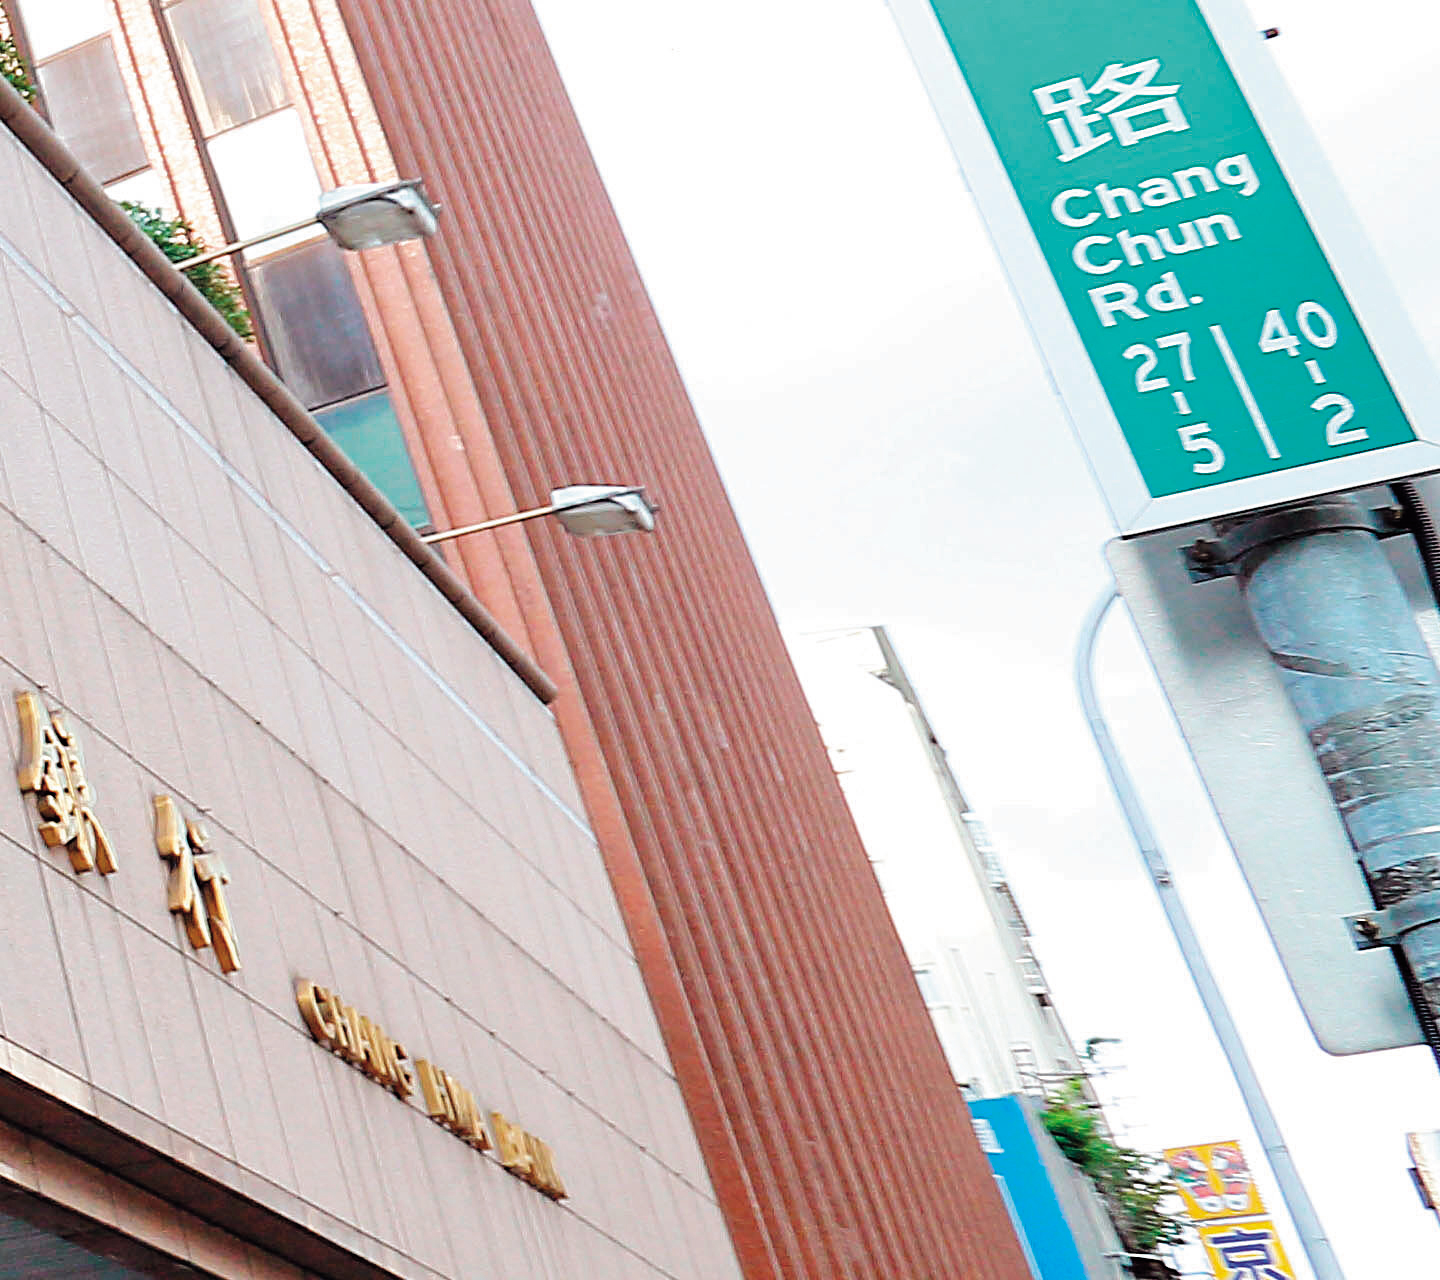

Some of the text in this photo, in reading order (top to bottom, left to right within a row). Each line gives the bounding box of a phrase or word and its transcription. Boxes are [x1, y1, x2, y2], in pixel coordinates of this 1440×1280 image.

[1051, 153, 1260, 228] Chang
[1072, 213, 1243, 275] Chun
[1087, 272, 1204, 327] Rd.
